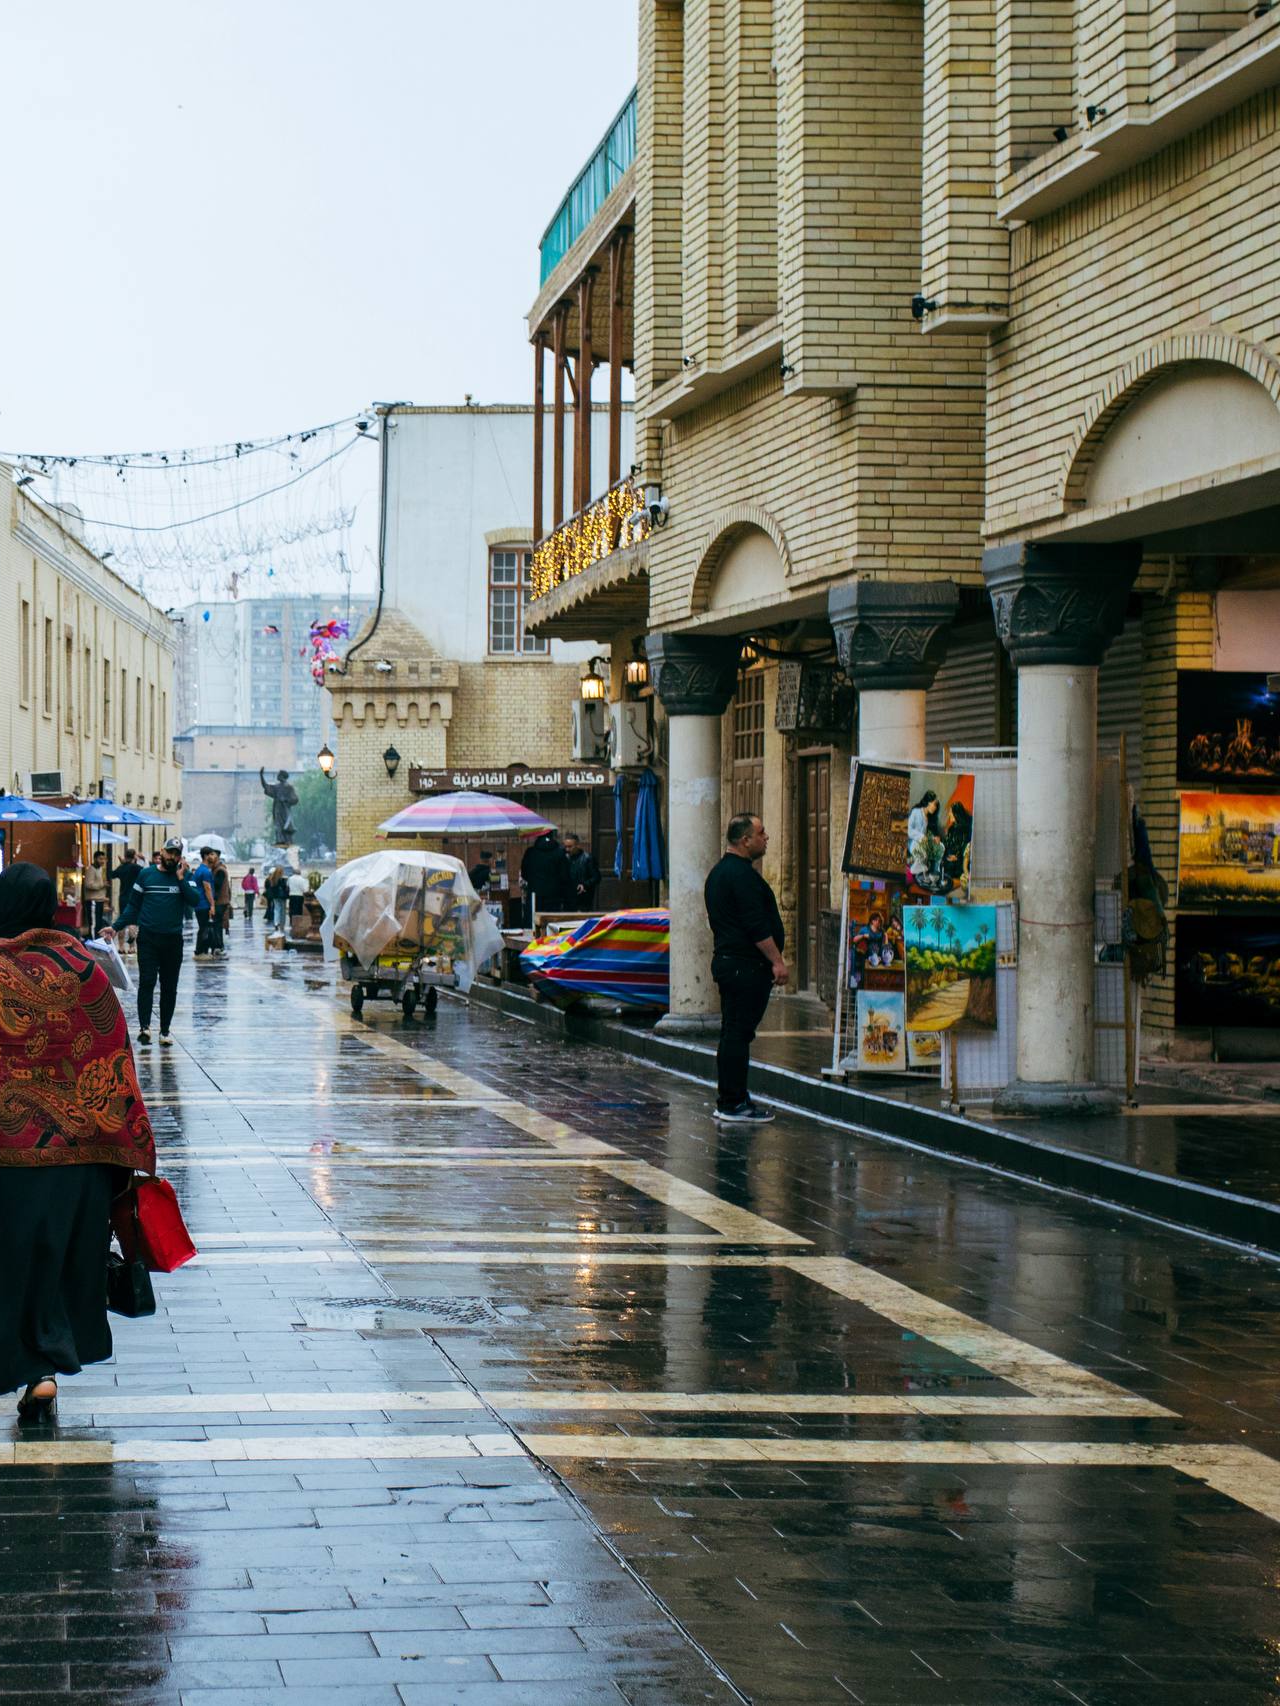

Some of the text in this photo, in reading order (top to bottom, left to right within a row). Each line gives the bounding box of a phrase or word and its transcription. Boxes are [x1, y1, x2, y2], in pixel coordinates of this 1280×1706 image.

[452, 771, 507, 787] القانونية
[512, 771, 561, 788] المحاكم
[567, 771, 604, 787] مكتبة
